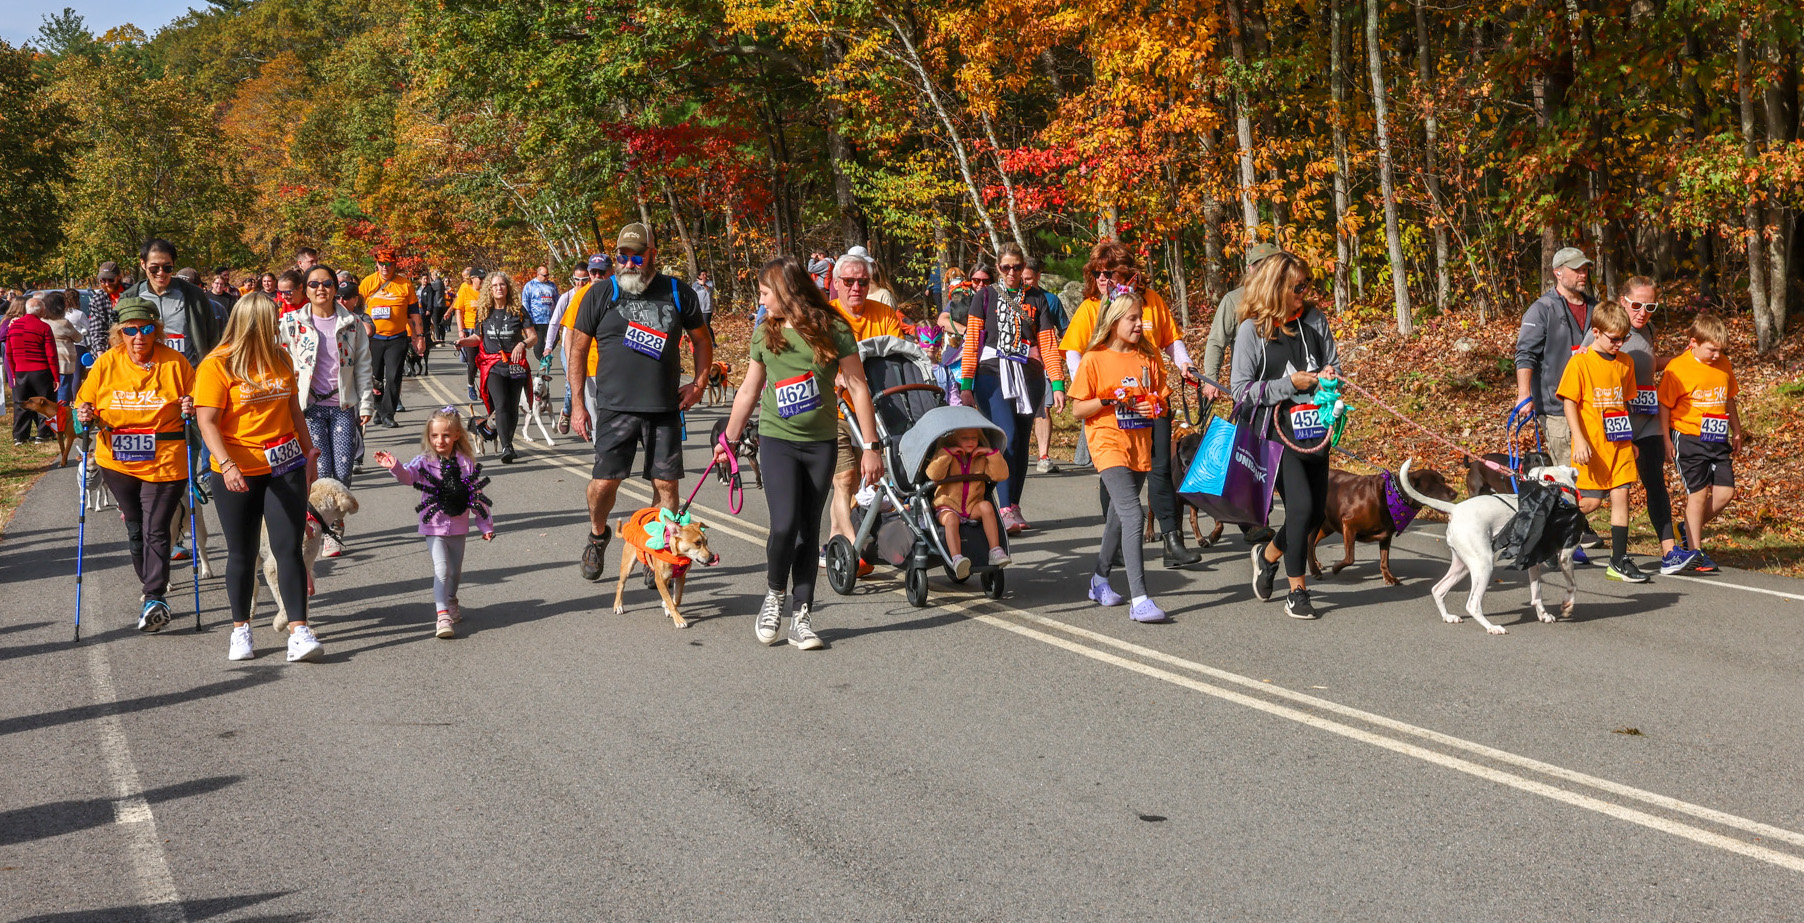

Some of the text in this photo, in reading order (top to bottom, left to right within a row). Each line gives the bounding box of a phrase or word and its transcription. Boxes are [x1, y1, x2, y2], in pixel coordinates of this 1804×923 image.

[632, 310, 649, 322] EAT
[166, 339, 181, 351] 01
[627, 328, 663, 350] 4628
[267, 377, 285, 394] 5K
[778, 378, 815, 405] 4627
[1714, 386, 1726, 401] 5K
[136, 390, 156, 404] 5K
[1631, 391, 1656, 405] 353
[1294, 410, 1322, 428] 452
[112, 435, 154, 450] 4315
[270, 438, 300, 464] 4383
[1235, 451, 1268, 484] UNIBANK
